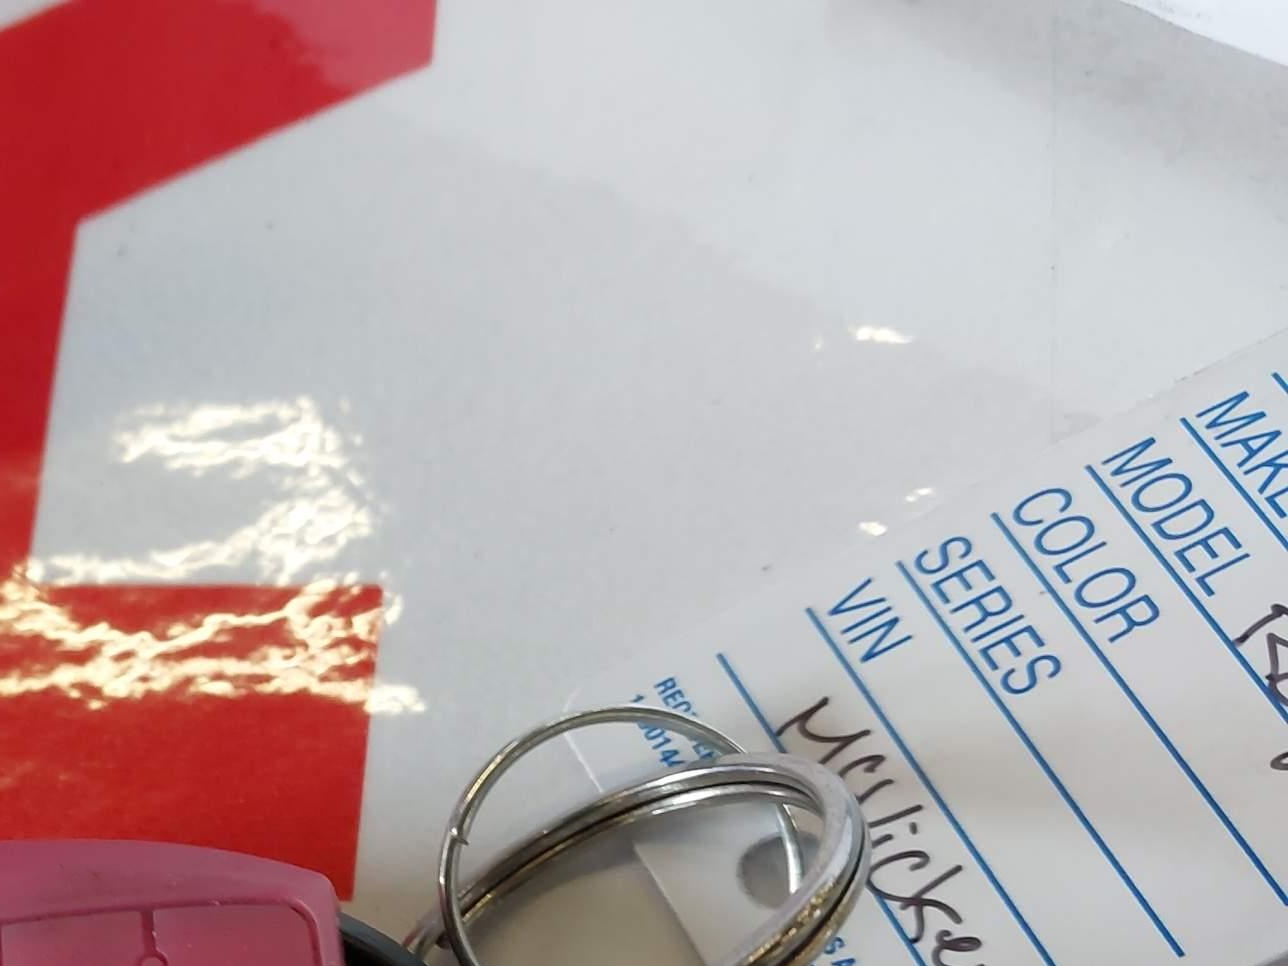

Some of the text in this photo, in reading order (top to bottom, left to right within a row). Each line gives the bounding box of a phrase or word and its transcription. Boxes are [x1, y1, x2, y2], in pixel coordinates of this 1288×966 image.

[1012, 487, 1160, 644] COLOR
[1101, 436, 1251, 597] MODEL
[827, 577, 914, 664] VIN
[914, 536, 1062, 695] SERIES
